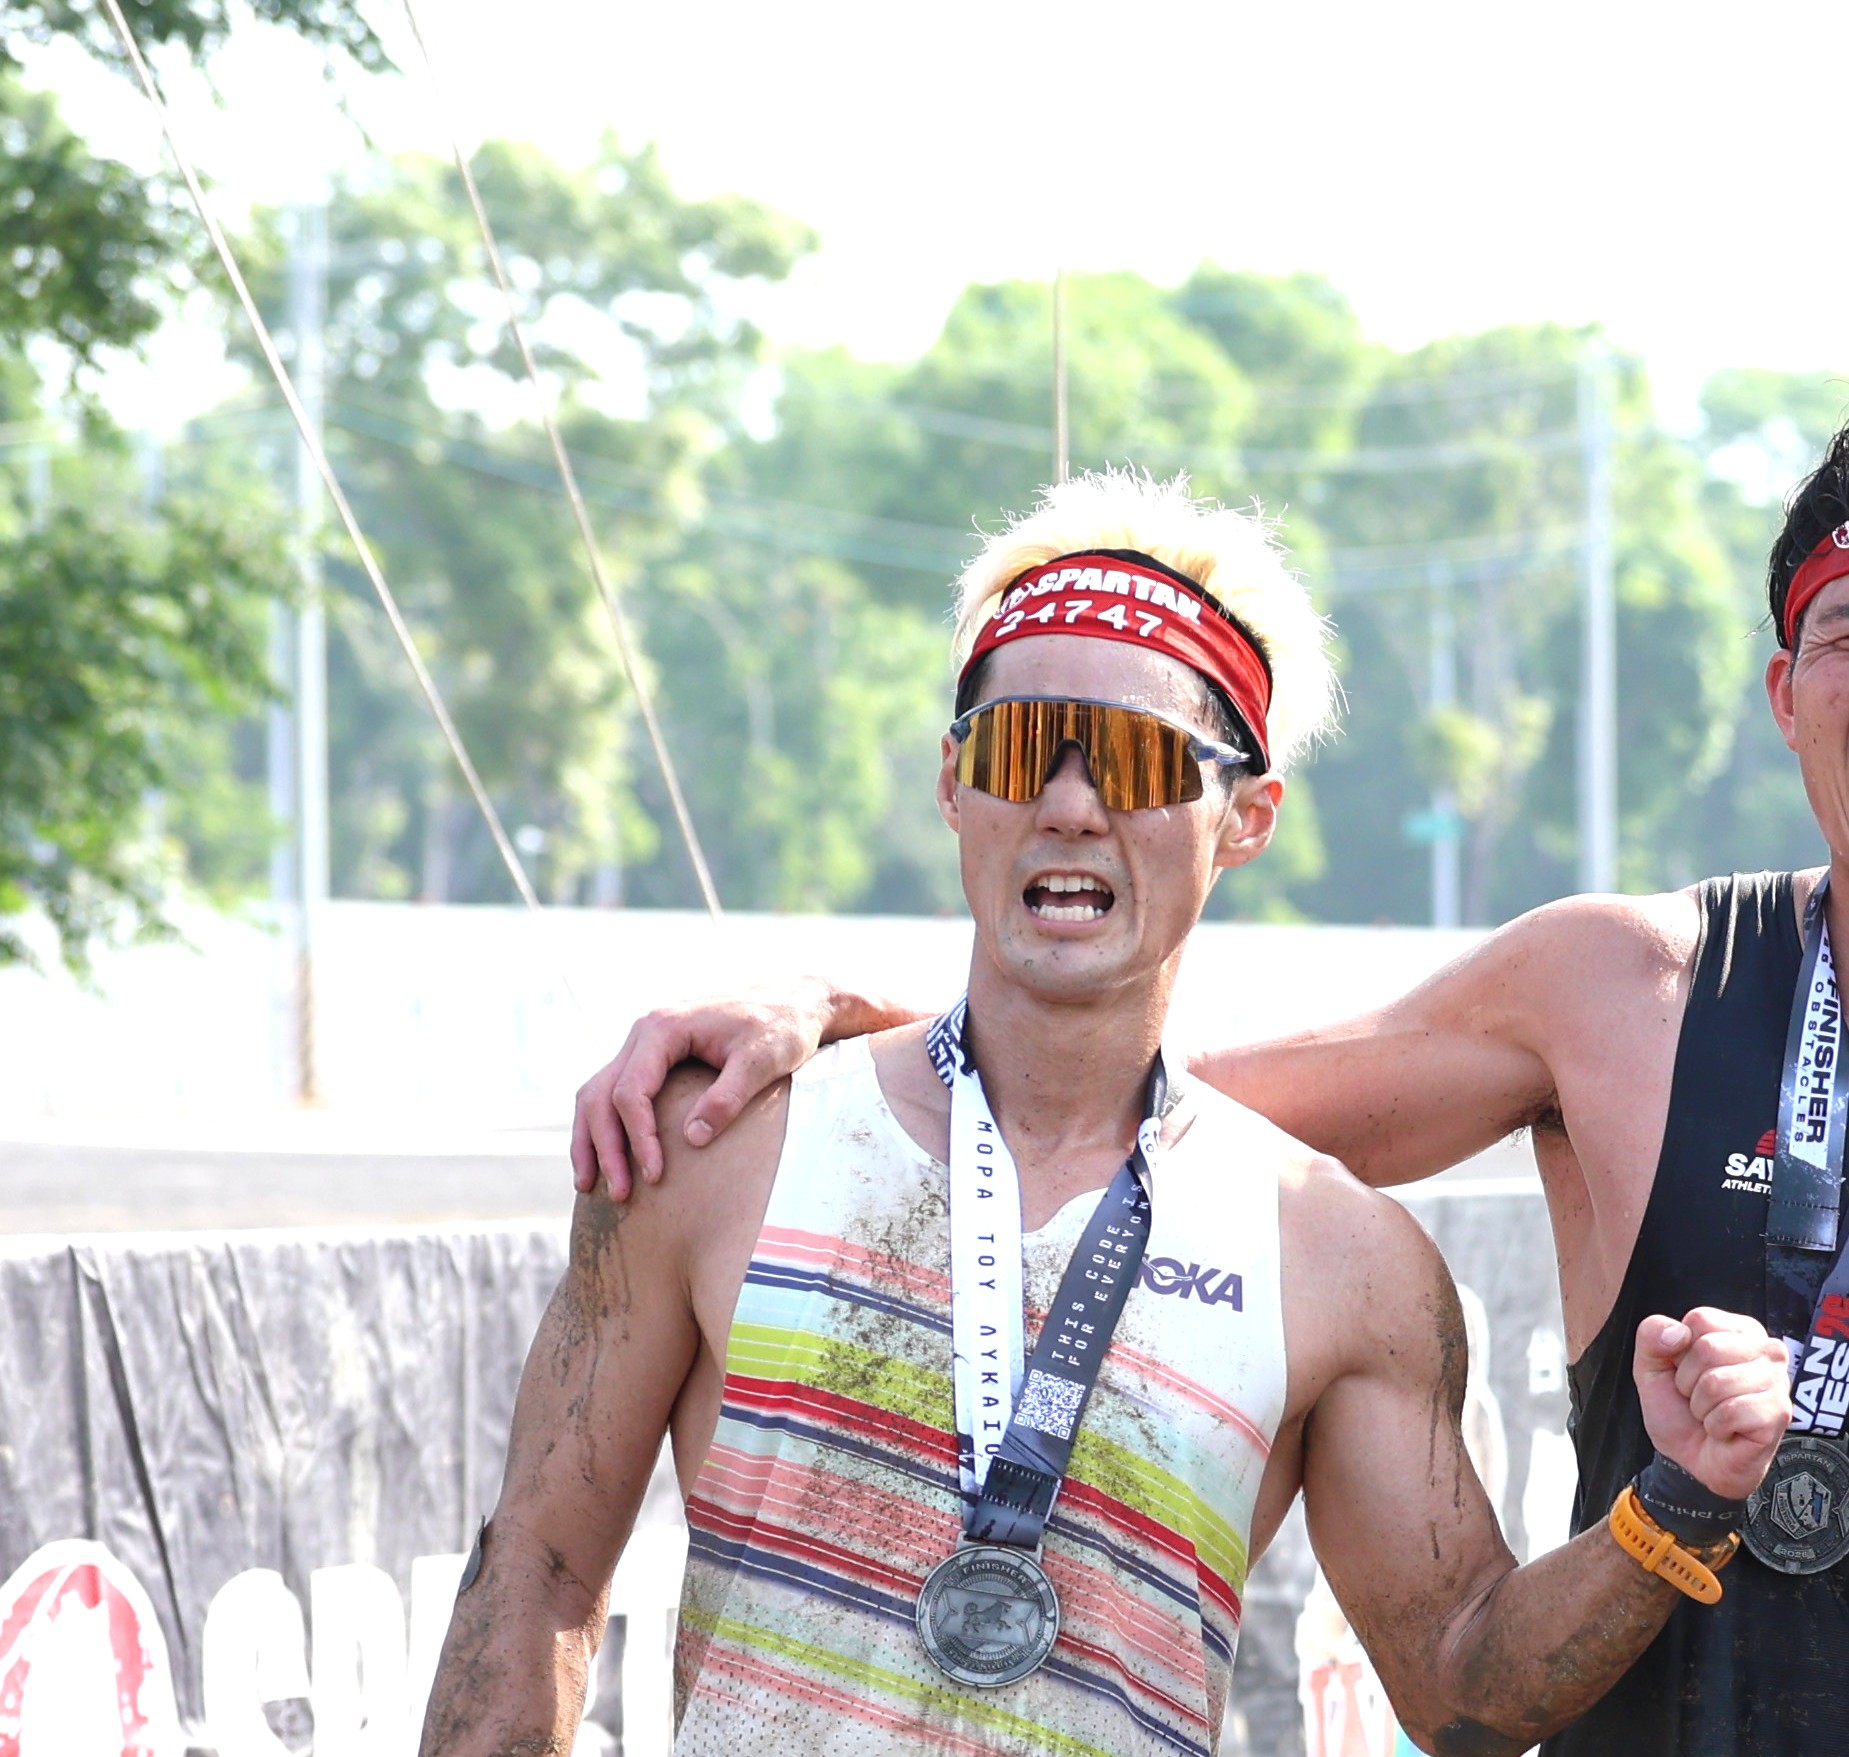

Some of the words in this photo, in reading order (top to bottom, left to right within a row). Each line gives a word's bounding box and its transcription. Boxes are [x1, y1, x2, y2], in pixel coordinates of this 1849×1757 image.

[994, 599, 1163, 638] 24747
[1037, 567, 1201, 623] SPARTAN
[1795, 982, 1825, 1143] OBSTACLES
[1805, 976, 1840, 1145] FINISHER
[1051, 1302, 1084, 1361] THIS
[1086, 1225, 1120, 1281] CODE
[1068, 1322, 1094, 1366] FOR
[963, 1560, 1028, 1585] FINISHER
